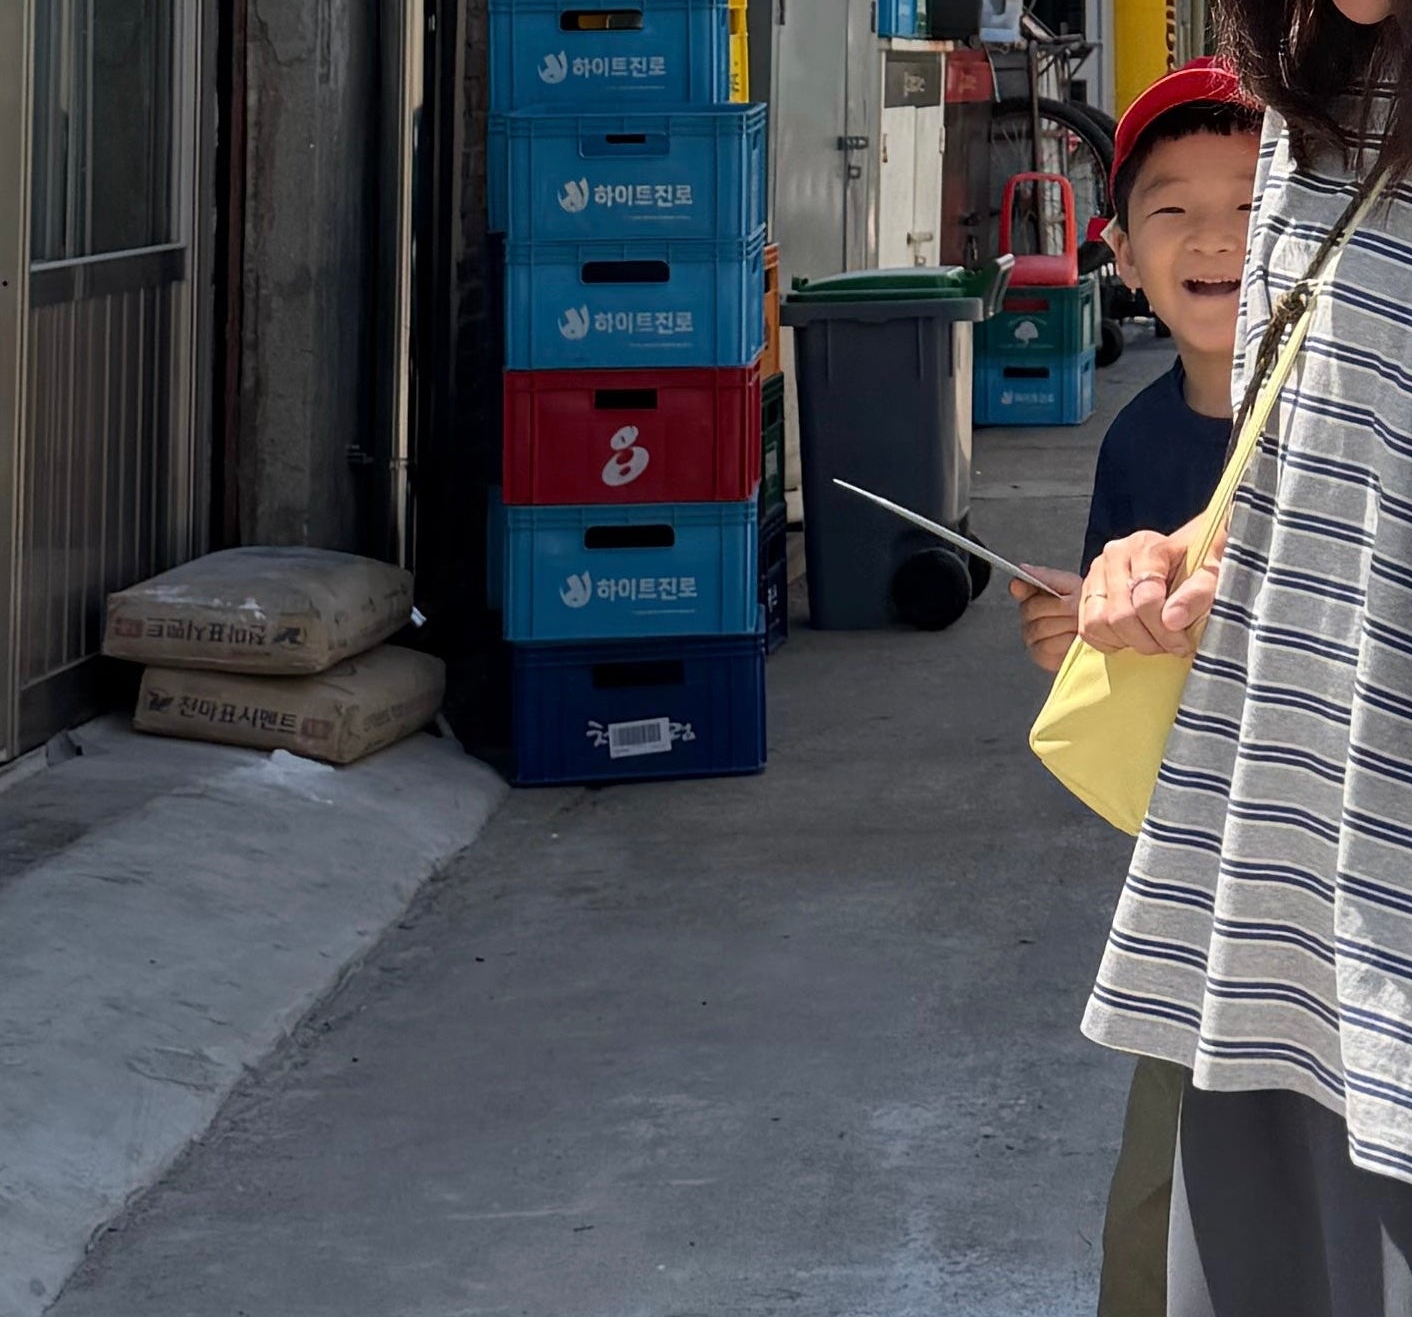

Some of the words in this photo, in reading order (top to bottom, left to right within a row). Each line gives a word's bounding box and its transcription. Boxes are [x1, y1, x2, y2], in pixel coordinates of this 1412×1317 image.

[572, 57, 666, 78] 하이트진로
[594, 184, 693, 207] 하이트진로
[594, 311, 693, 334] 하이트진로
[597, 577, 697, 601] 하이트진로
[178, 695, 297, 734] 천마표시멘트
